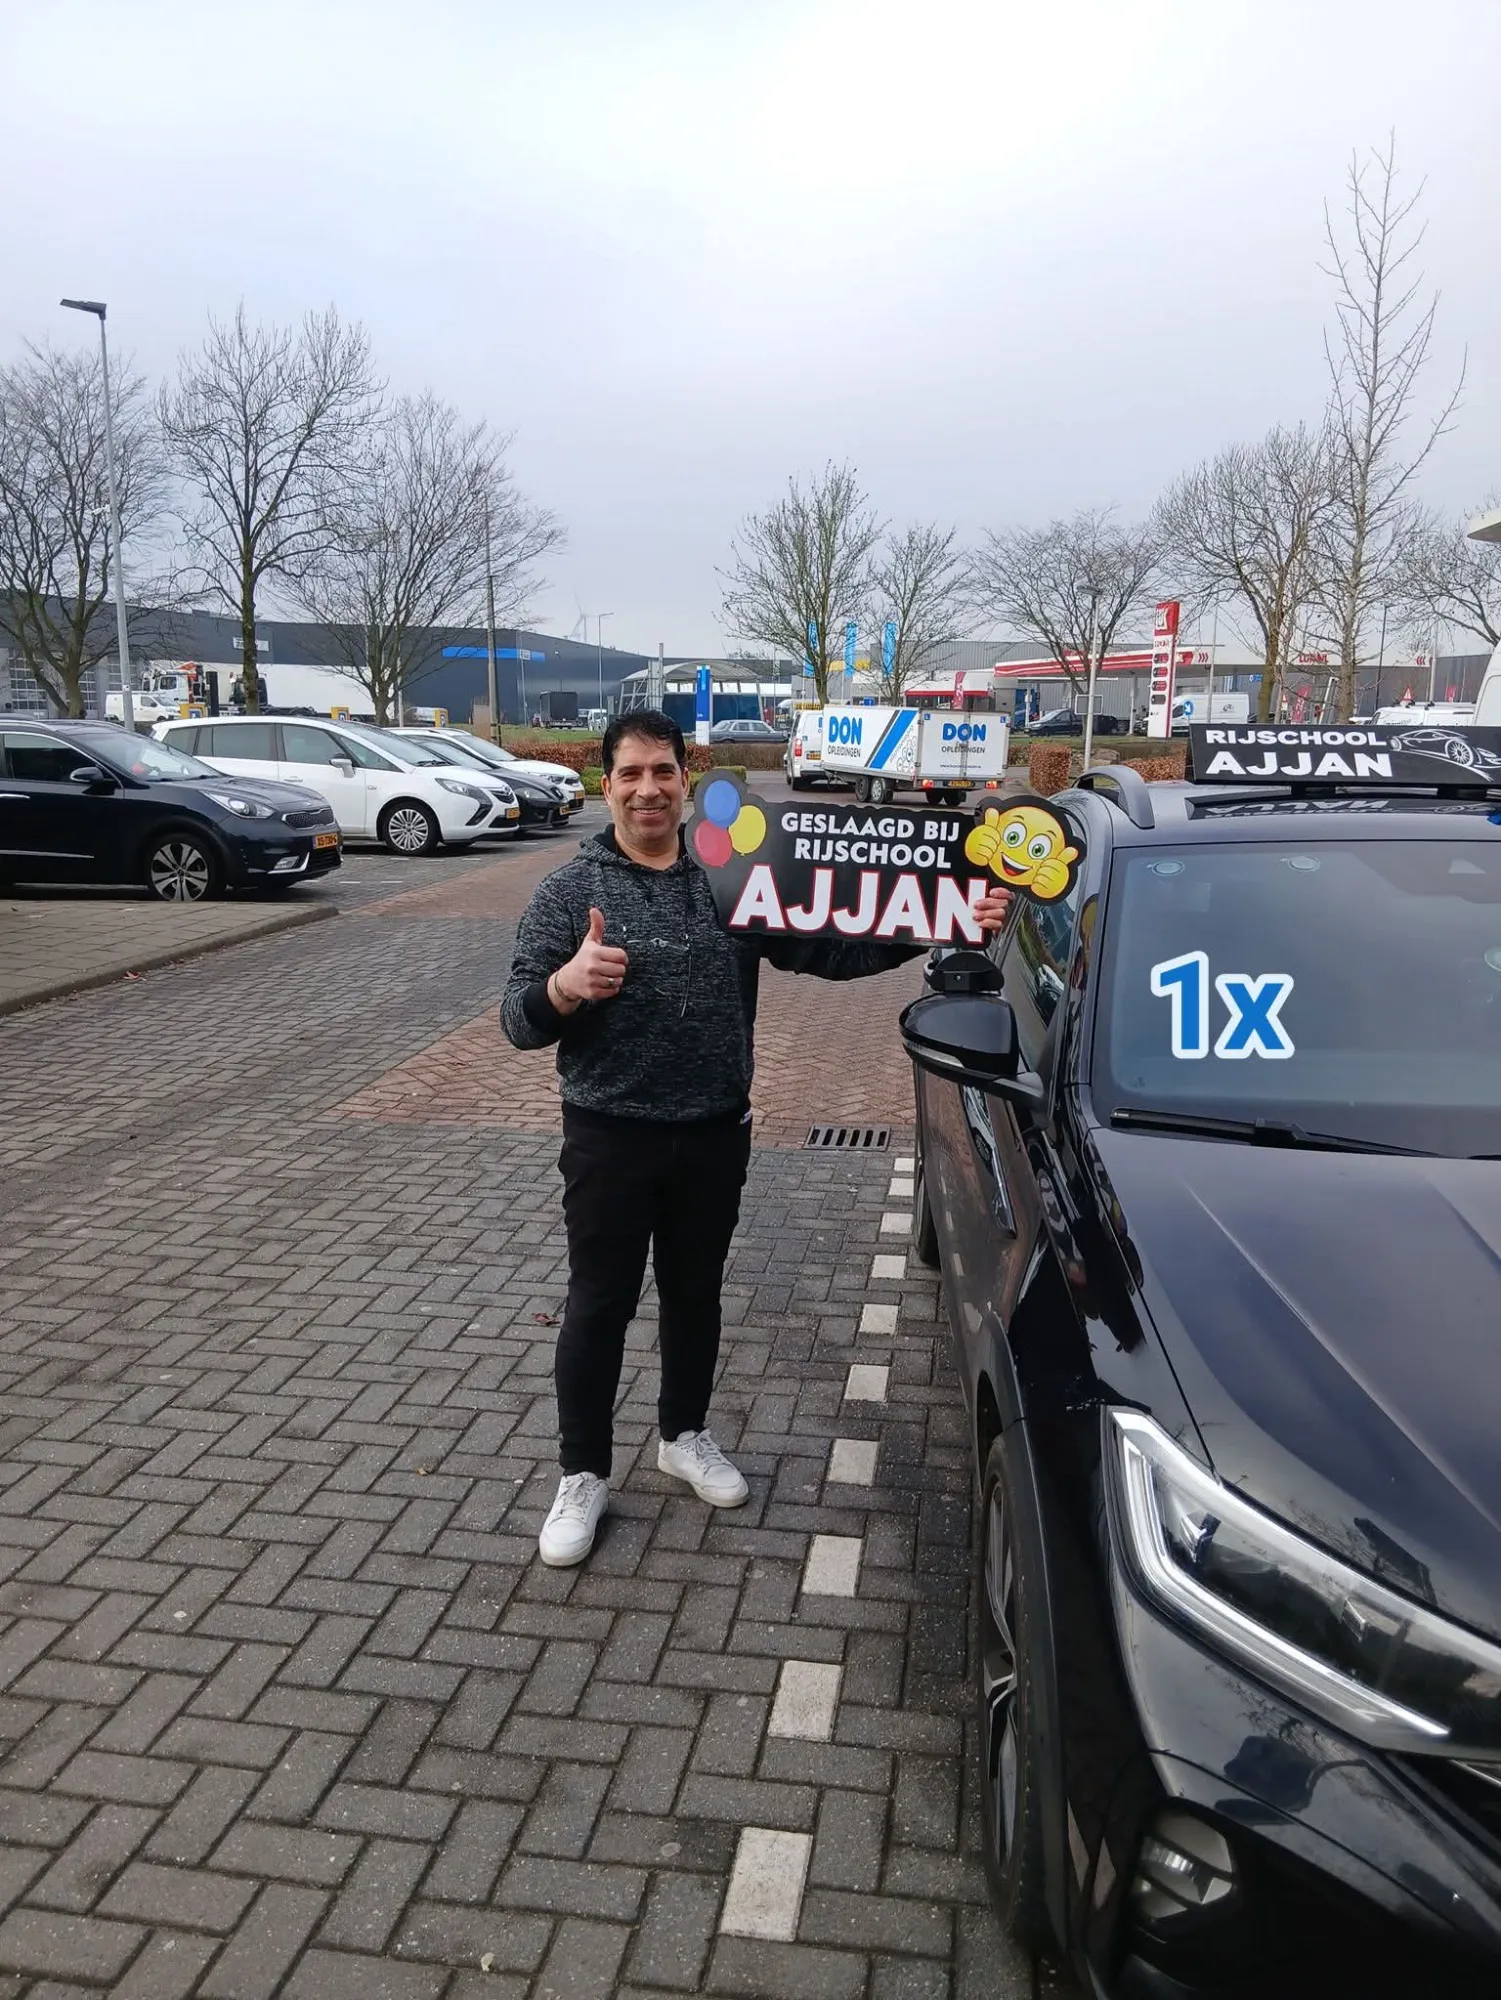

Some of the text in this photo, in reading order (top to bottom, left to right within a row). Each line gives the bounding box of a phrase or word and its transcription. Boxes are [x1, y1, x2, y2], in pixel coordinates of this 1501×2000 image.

[828, 716, 863, 745] DON
[942, 723, 987, 742] DON
[1206, 729, 1387, 747] RIJSCHOOL
[828, 745, 861, 758] OPLEIDINGEN
[1205, 751, 1393, 778] AJJAN
[781, 812, 960, 842] GESLAAGD BIJ
[794, 837, 952, 869] RIJSCHOOL
[729, 863, 990, 945] AJJAN
